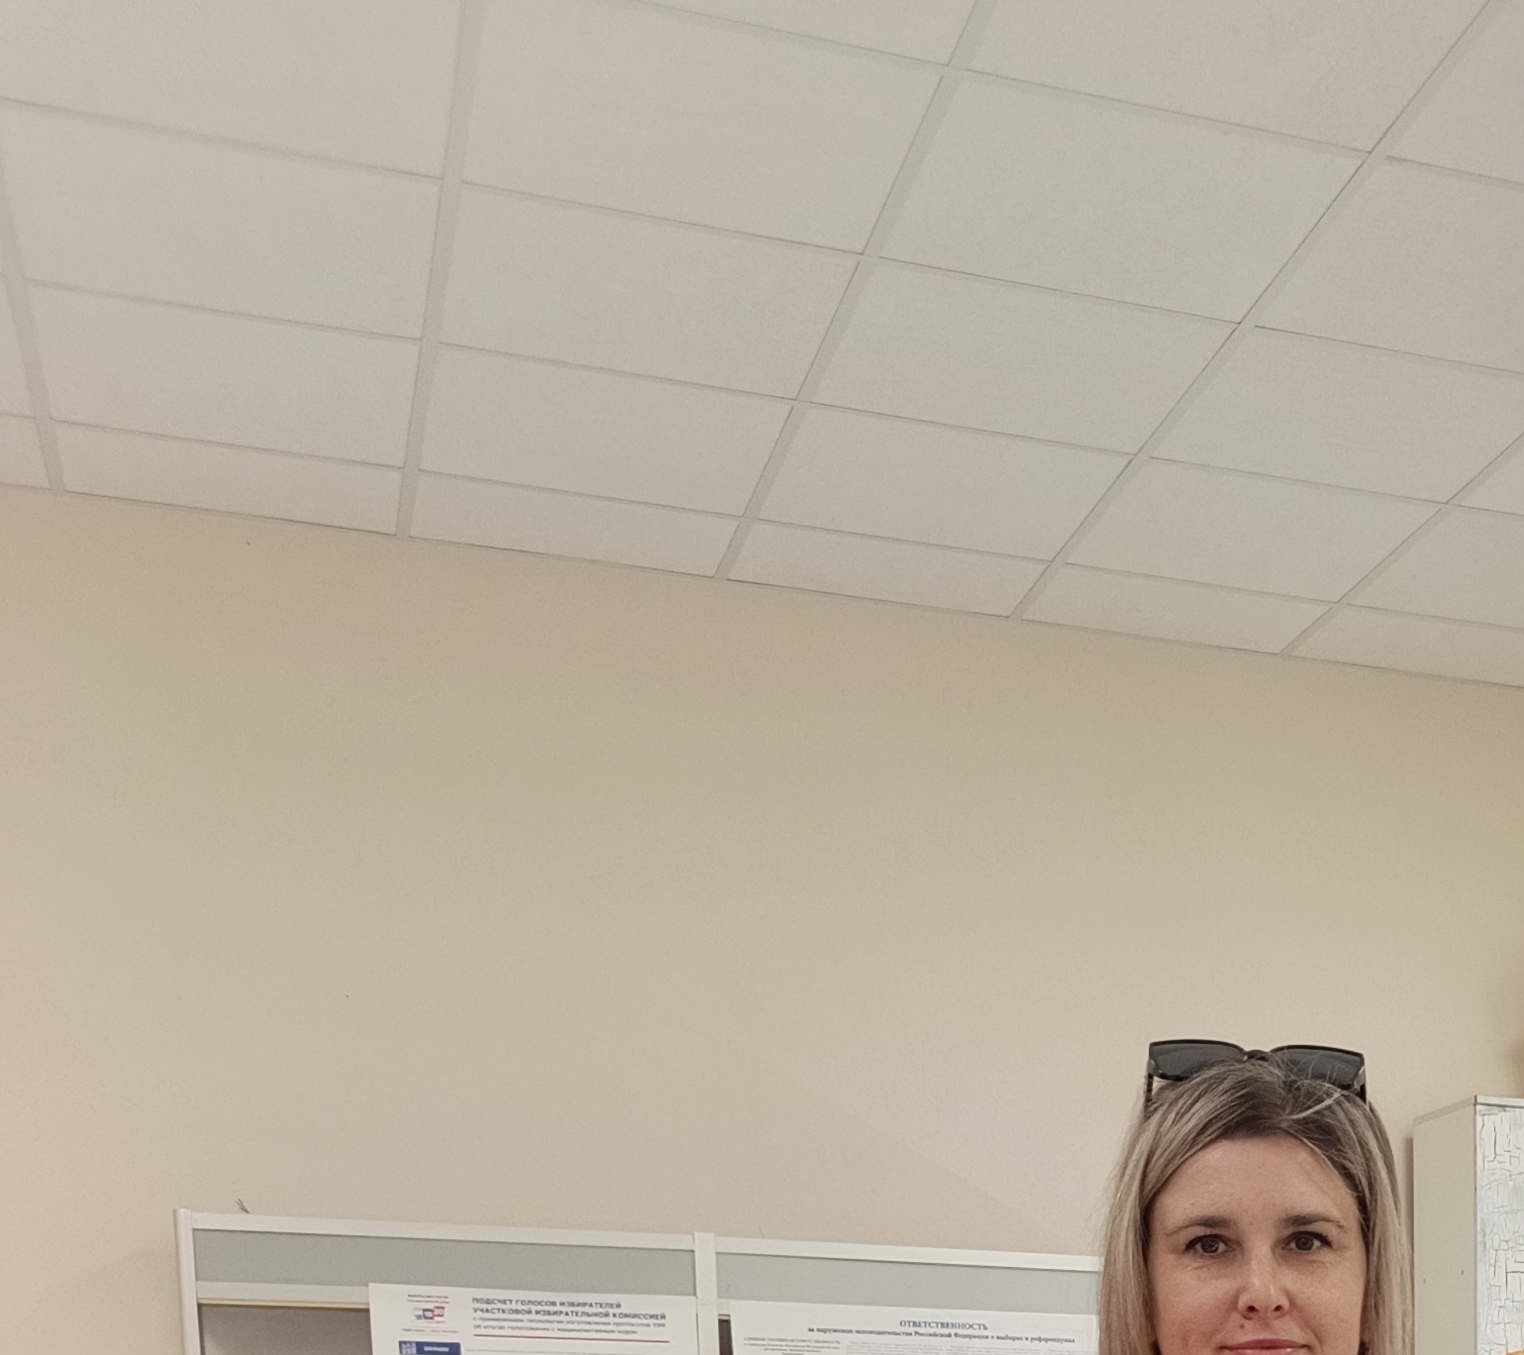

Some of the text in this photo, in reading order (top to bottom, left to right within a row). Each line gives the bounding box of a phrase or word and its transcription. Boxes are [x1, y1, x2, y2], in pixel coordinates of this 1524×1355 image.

[515, 1298, 557, 1307] ГОЛОСОВ
[559, 1300, 621, 1309] ИЗБИРАТЕЛЕЙ
[473, 1306, 666, 1320] УЧАСТКОВОЙ ИЗБИРАТЕЛЬНОЙ КОМИССИЕЙ
[900, 1320, 988, 1331] ОТВЕТСТВЕННОСТЬ
